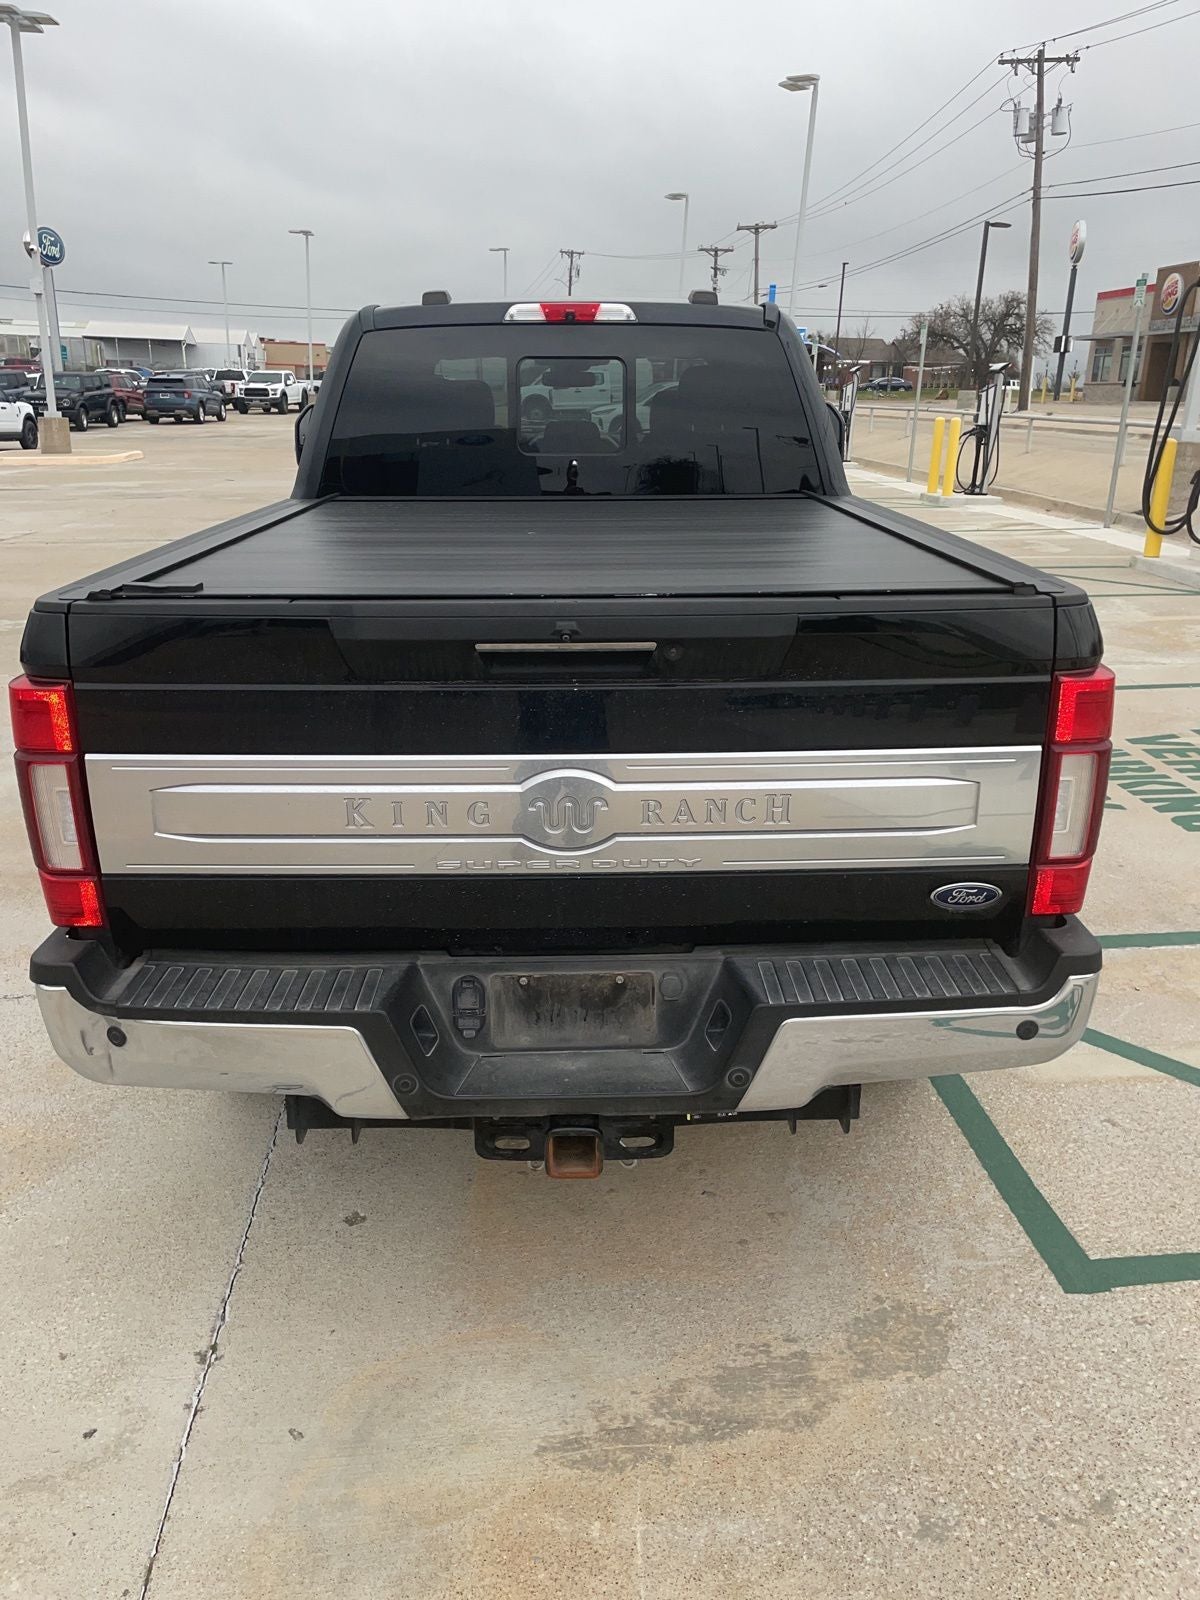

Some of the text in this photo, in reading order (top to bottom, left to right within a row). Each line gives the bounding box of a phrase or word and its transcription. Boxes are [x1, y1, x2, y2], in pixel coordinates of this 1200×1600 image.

[41, 233, 60, 258] Ford
[343, 793, 792, 829] KING RANCH
[436, 858, 702, 870] SUPER DUTY
[947, 888, 987, 904] Ford
